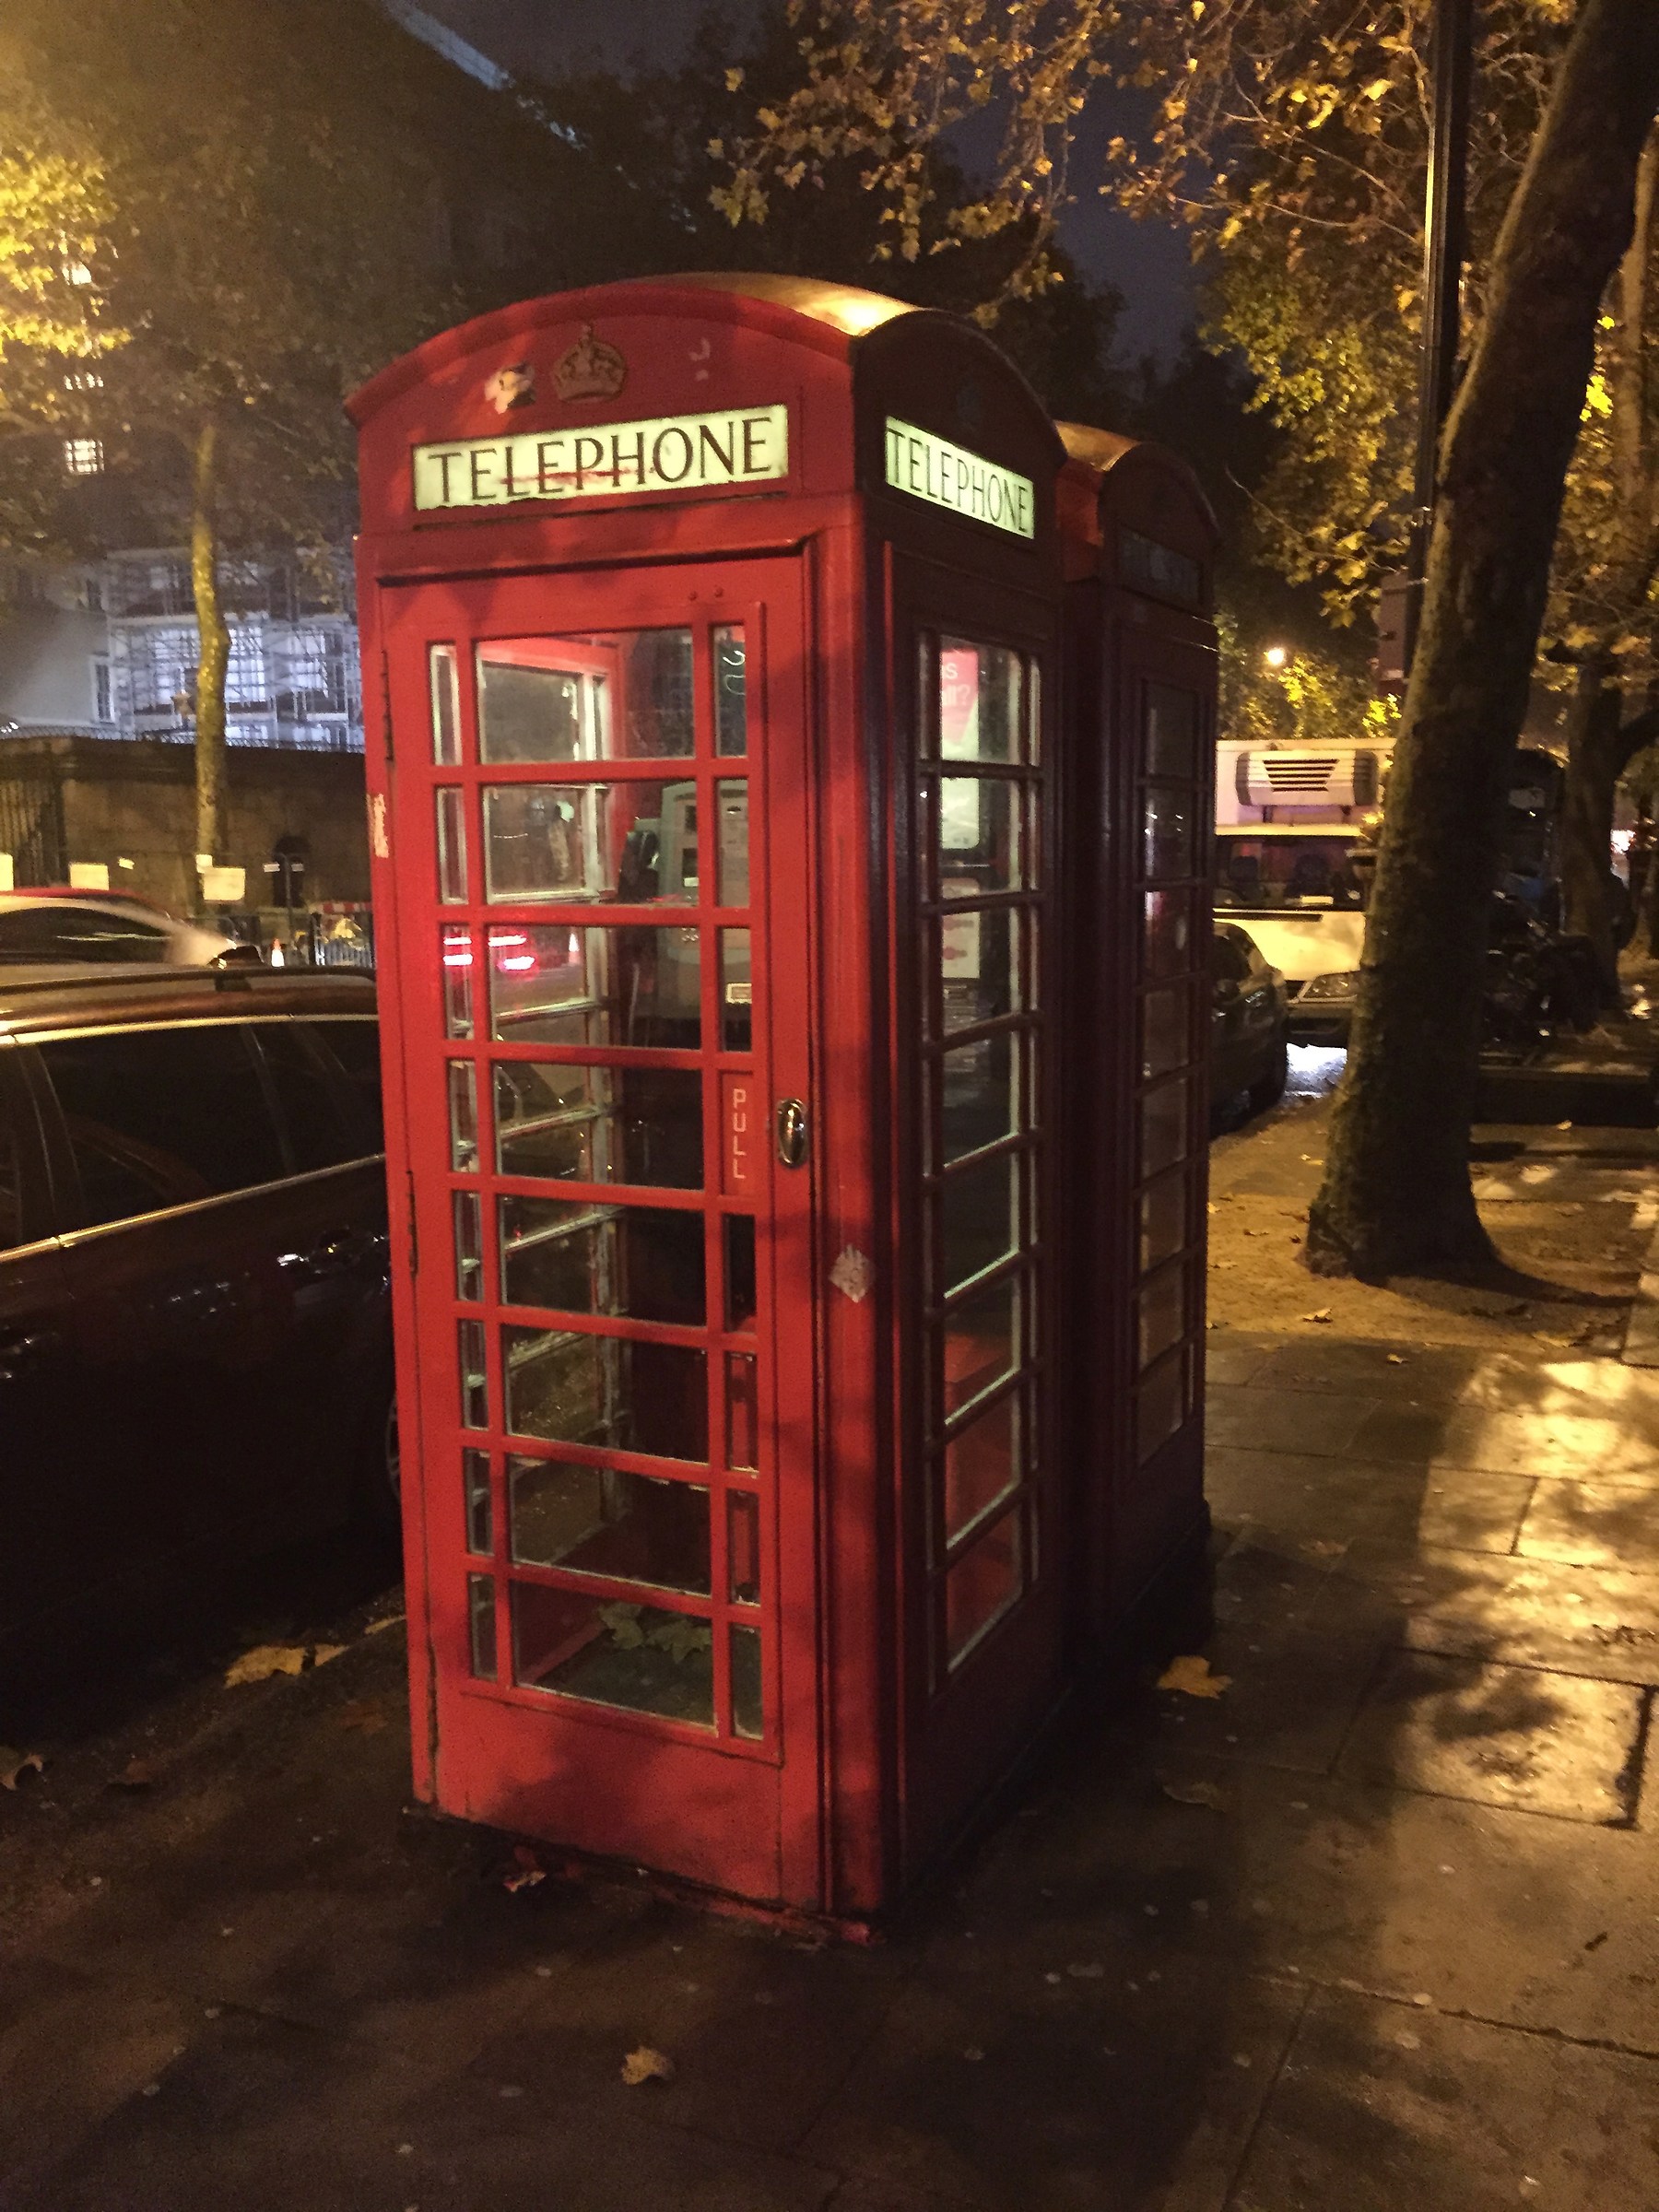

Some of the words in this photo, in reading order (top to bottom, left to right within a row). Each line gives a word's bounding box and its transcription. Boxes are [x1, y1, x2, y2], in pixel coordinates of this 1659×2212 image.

[428, 417, 772, 502] TELEPHONE
[886, 428, 1028, 533] TELEPHONE
[733, 1088, 747, 1179] PULL
